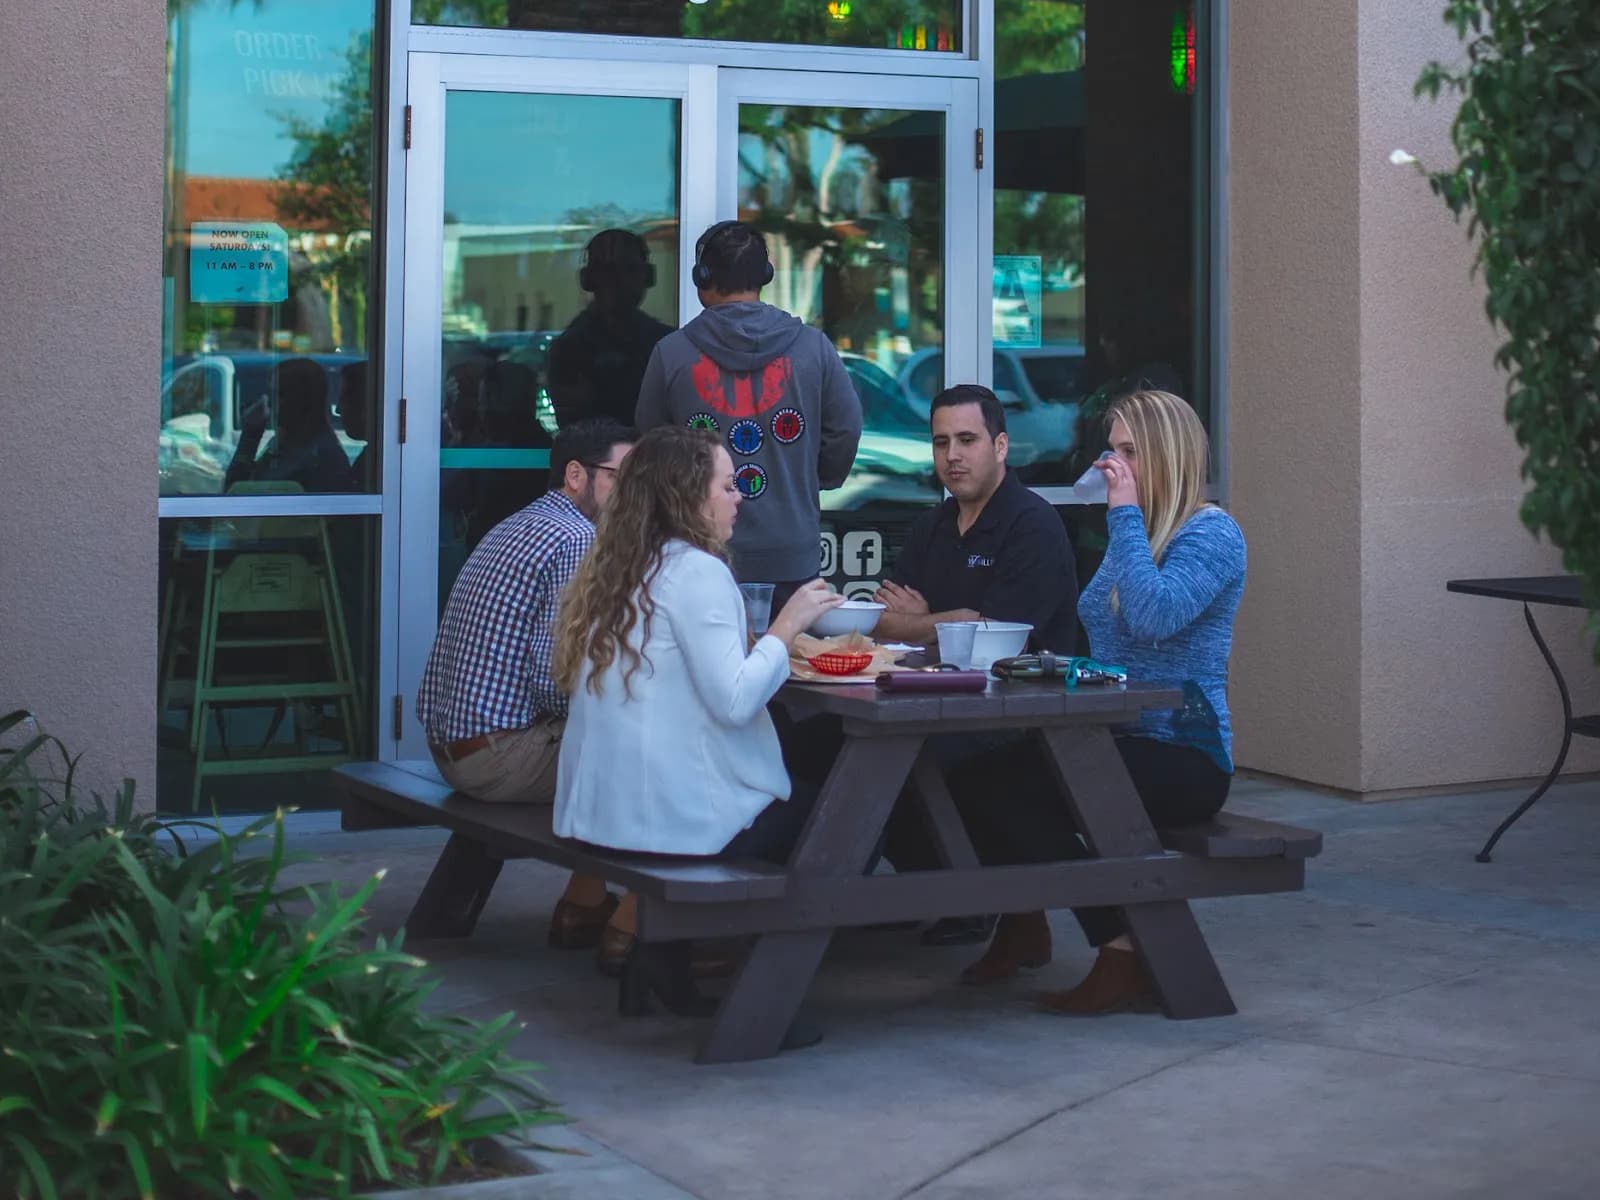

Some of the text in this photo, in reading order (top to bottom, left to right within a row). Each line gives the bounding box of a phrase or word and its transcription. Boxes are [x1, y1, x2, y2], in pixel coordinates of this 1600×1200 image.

[233, 30, 322, 61] ORDER
[211, 230, 269, 239] NOW OPEN
[206, 262, 217, 270] 11
[221, 262, 237, 270] AM
[249, 262, 255, 270] 8
[258, 261, 273, 270] PM
